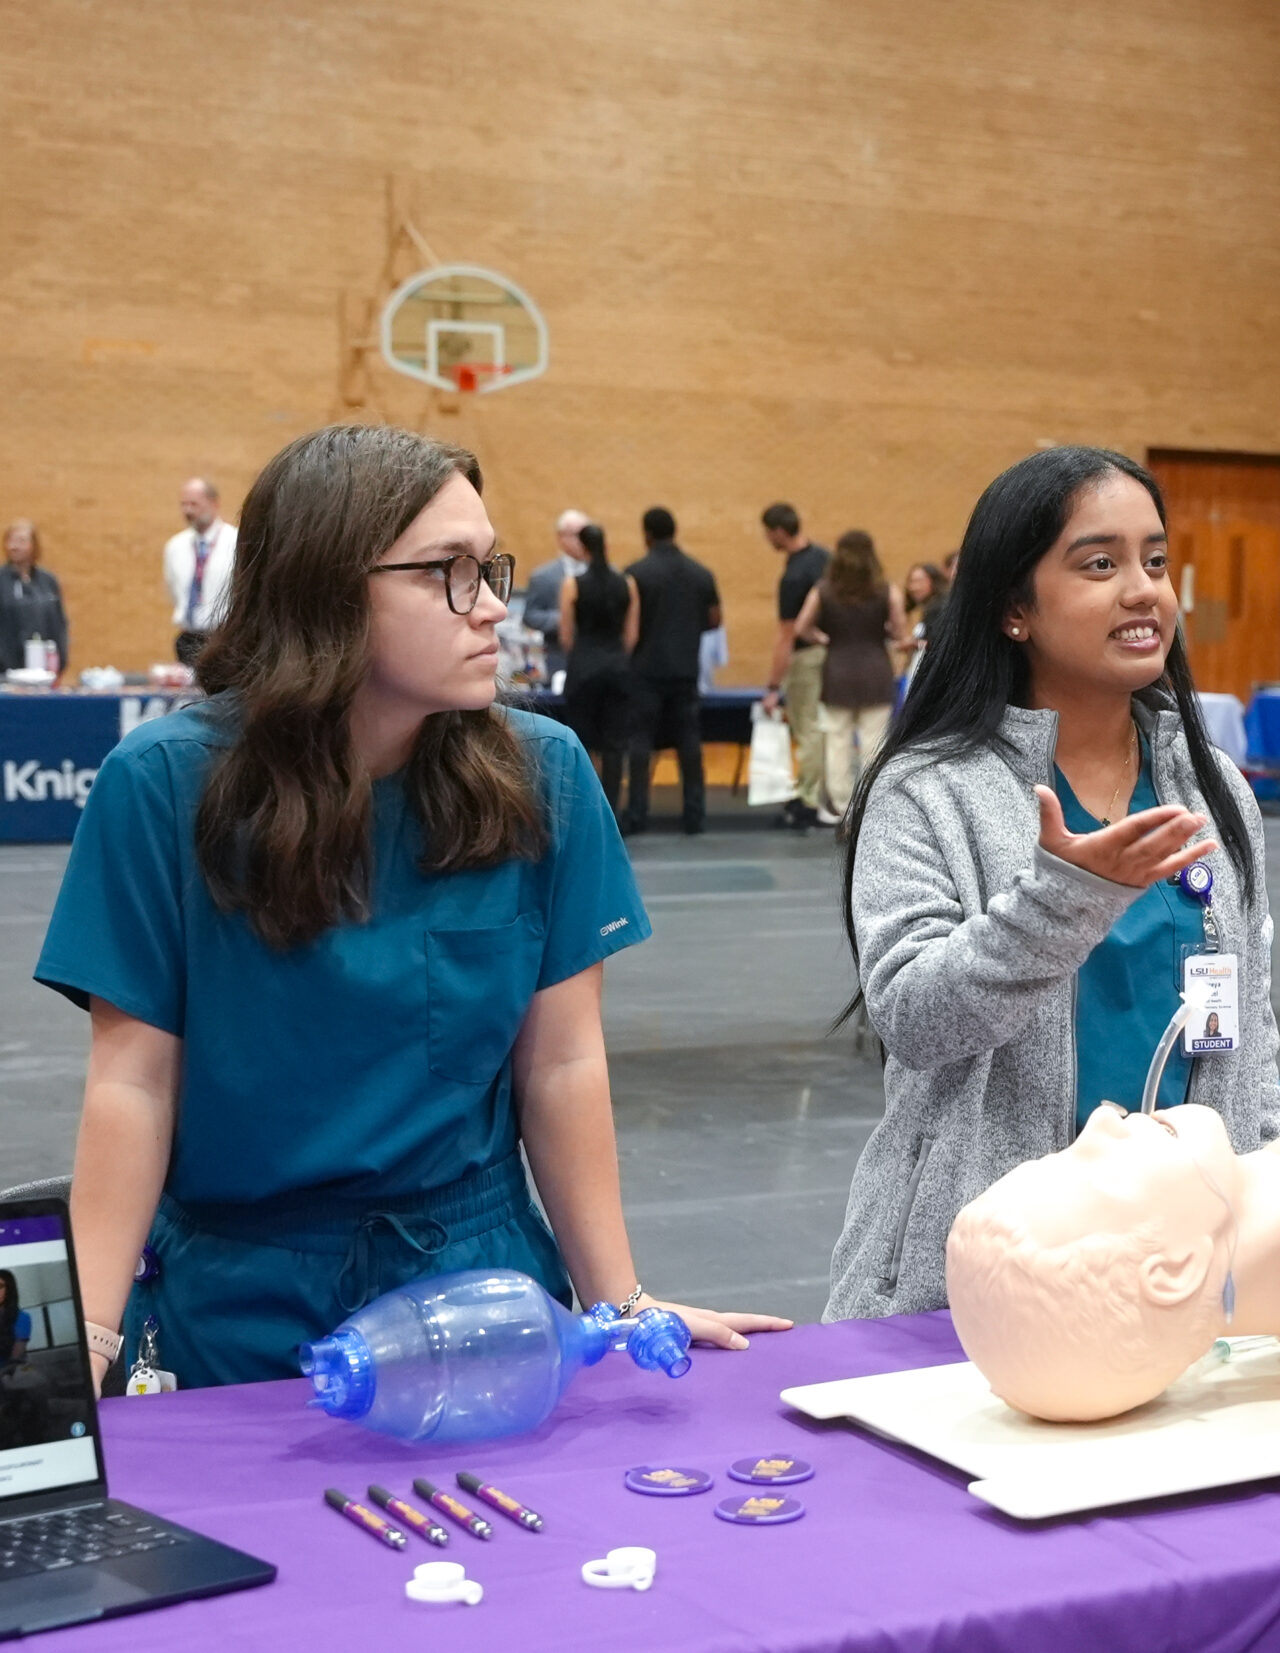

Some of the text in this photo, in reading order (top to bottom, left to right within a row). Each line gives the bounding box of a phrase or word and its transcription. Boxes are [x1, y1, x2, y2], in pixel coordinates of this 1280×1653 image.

[607, 917, 629, 932] Wink
[1190, 967, 1232, 976] LSU Health
[1194, 1039, 1231, 1049] STUDENT
